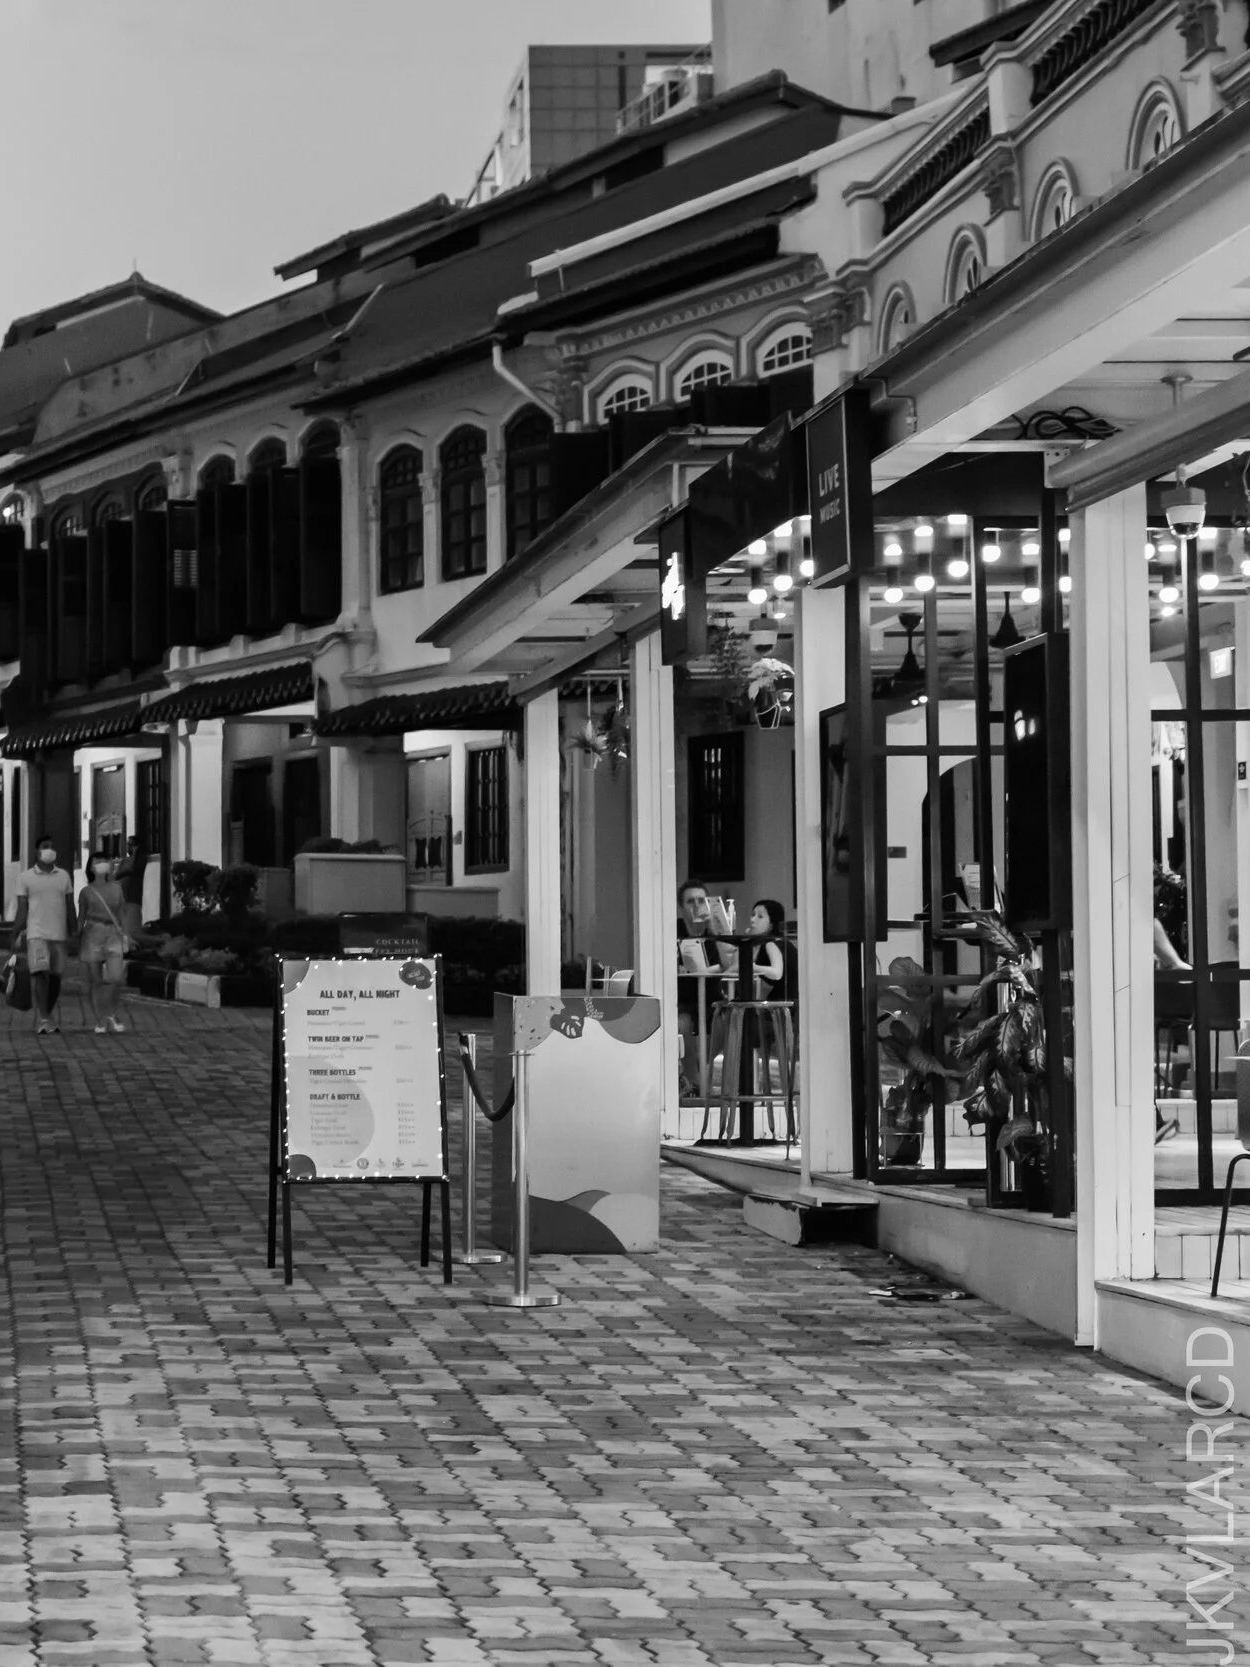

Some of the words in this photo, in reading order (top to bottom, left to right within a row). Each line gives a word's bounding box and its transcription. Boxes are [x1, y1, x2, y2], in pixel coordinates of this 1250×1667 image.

[818, 463, 840, 497] LIVE
[819, 498, 840, 524] MUSIC
[375, 938, 419, 946] COCKTAIL
[320, 990, 334, 999] ALL
[337, 990, 357, 1002] DAY,
[359, 990, 373, 999] ALL
[376, 990, 400, 999] NIGHT
[331, 1093, 336, 1101] &
[337, 1093, 361, 1101] BOTTLE
